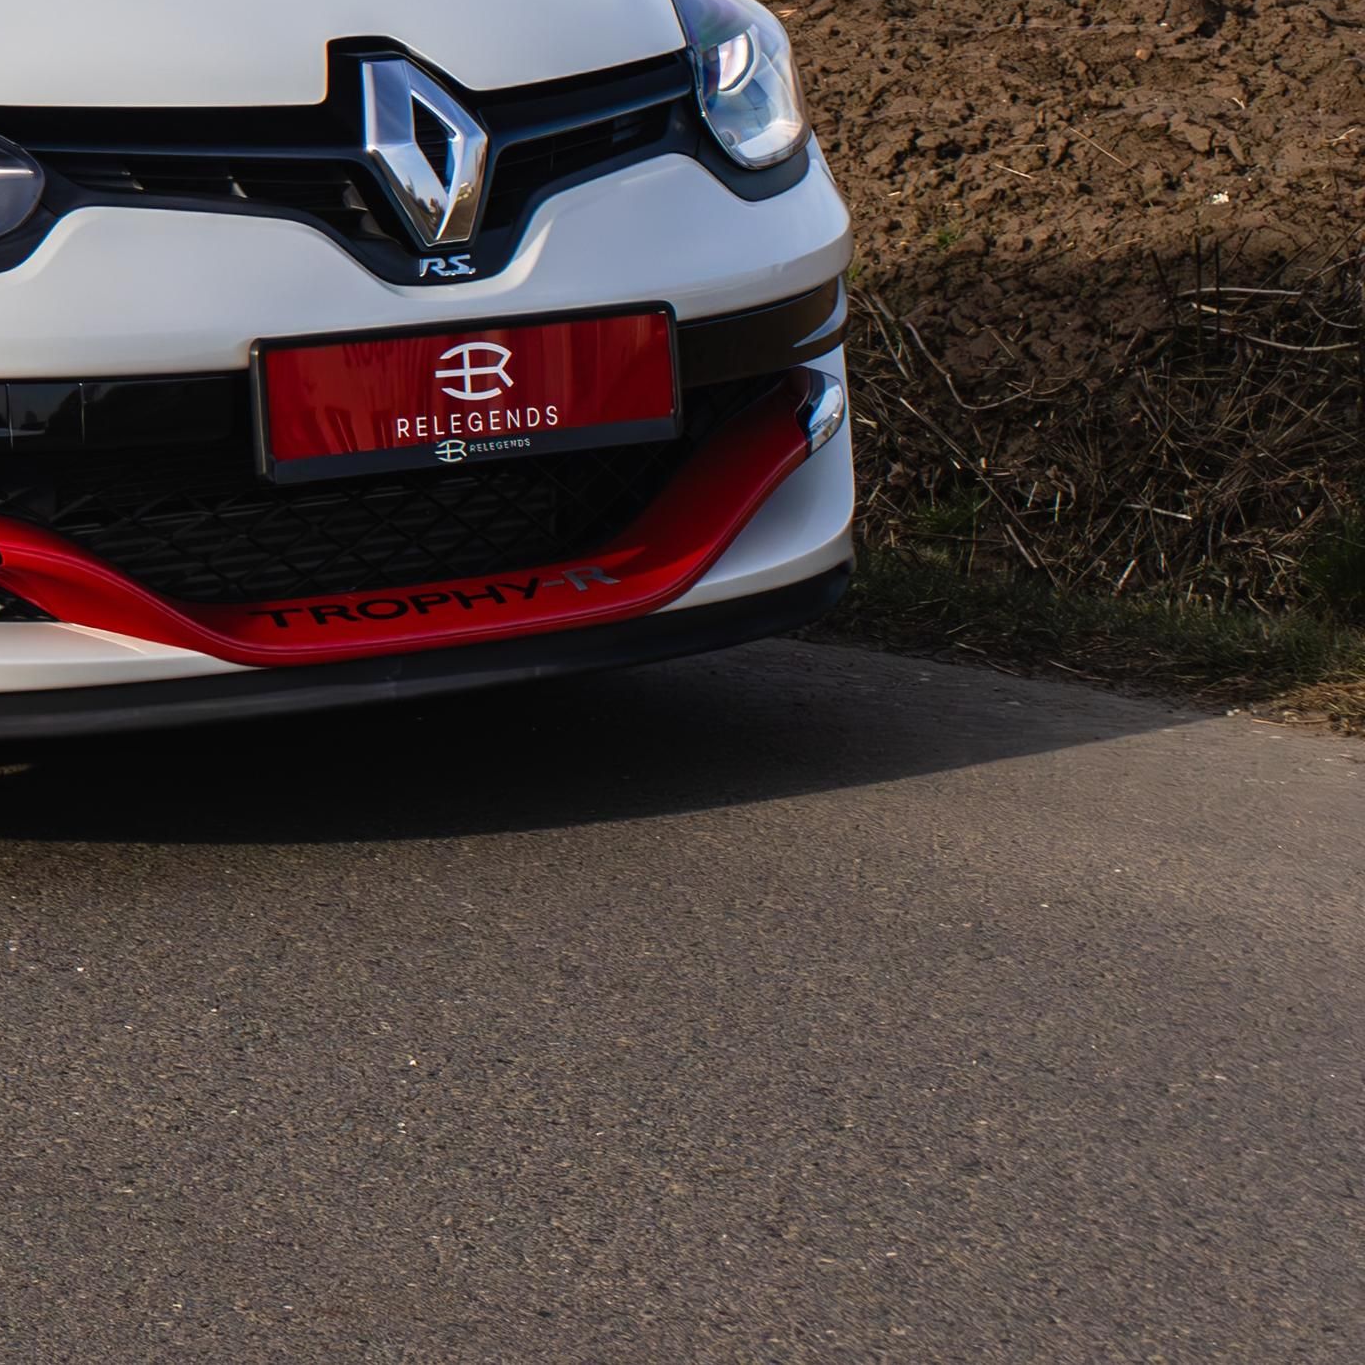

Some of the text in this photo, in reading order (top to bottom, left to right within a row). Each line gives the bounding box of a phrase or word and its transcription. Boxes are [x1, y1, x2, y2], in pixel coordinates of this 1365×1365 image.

[397, 405, 558, 438] RELEGENDS
[470, 438, 531, 452] RELEGENDS
[248, 565, 621, 628] TROPHY-R
